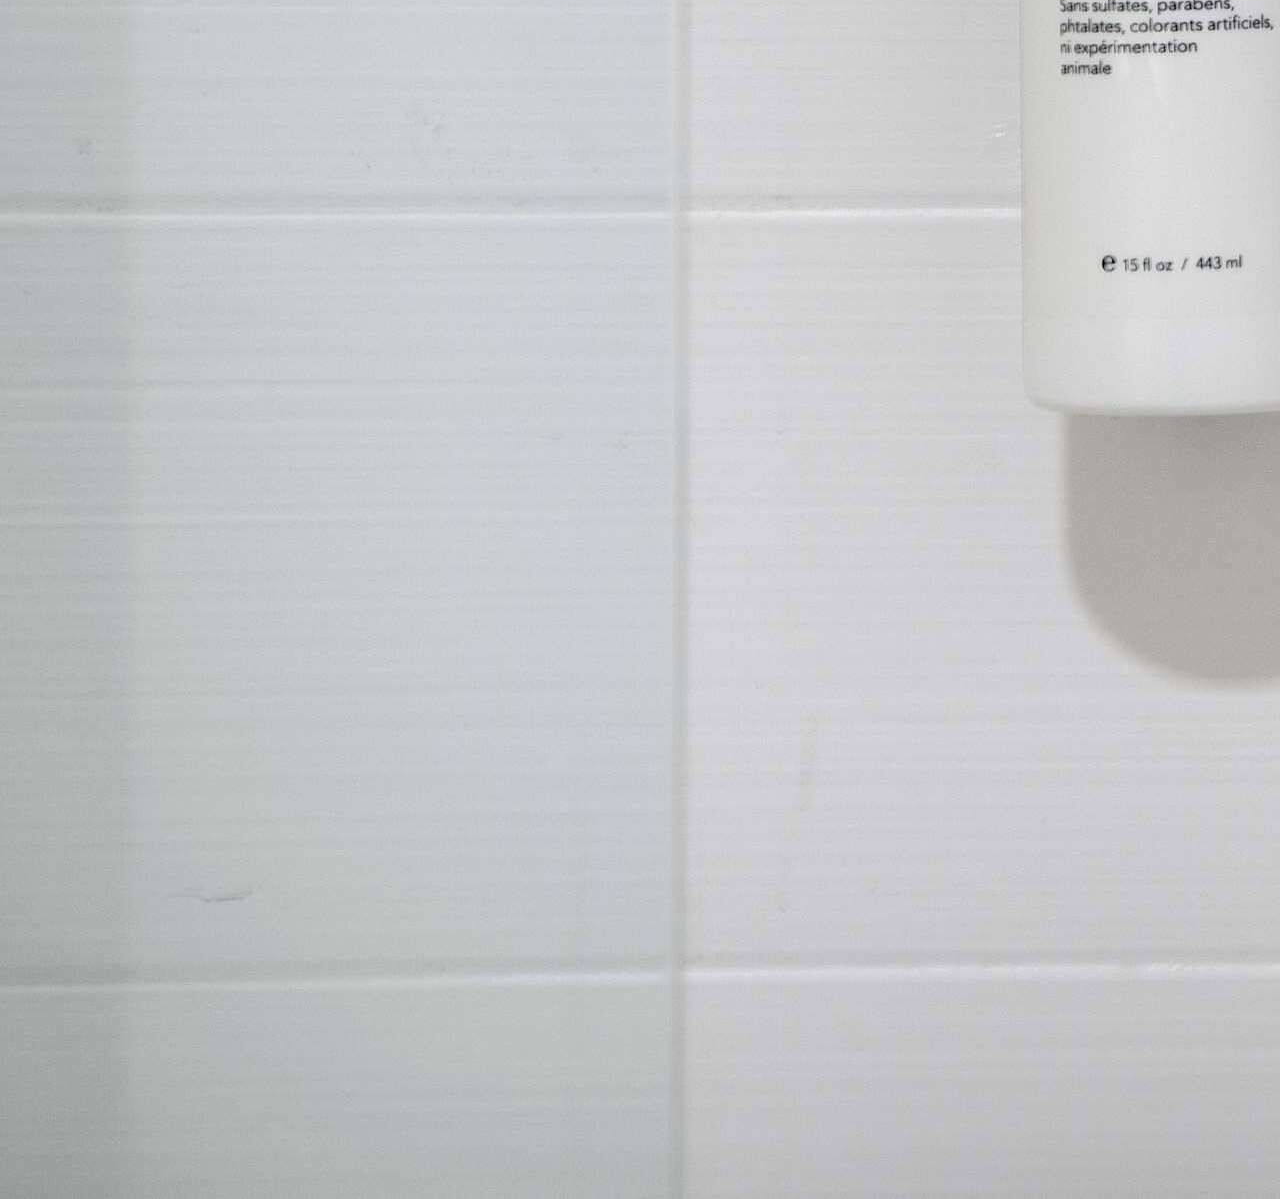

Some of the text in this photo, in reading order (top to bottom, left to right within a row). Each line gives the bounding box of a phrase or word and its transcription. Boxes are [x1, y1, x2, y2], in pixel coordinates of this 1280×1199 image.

[1060, 15, 1274, 35] phtalates, colorants artificiels,
[1060, 39, 1198, 58] ni expérimentation
[1061, 60, 1112, 74] animale
[1123, 259, 1139, 272] 15
[1143, 258, 1152, 271] fl
[1156, 261, 1173, 271] oz
[1196, 256, 1222, 269] 443
[1226, 254, 1242, 269] ml
